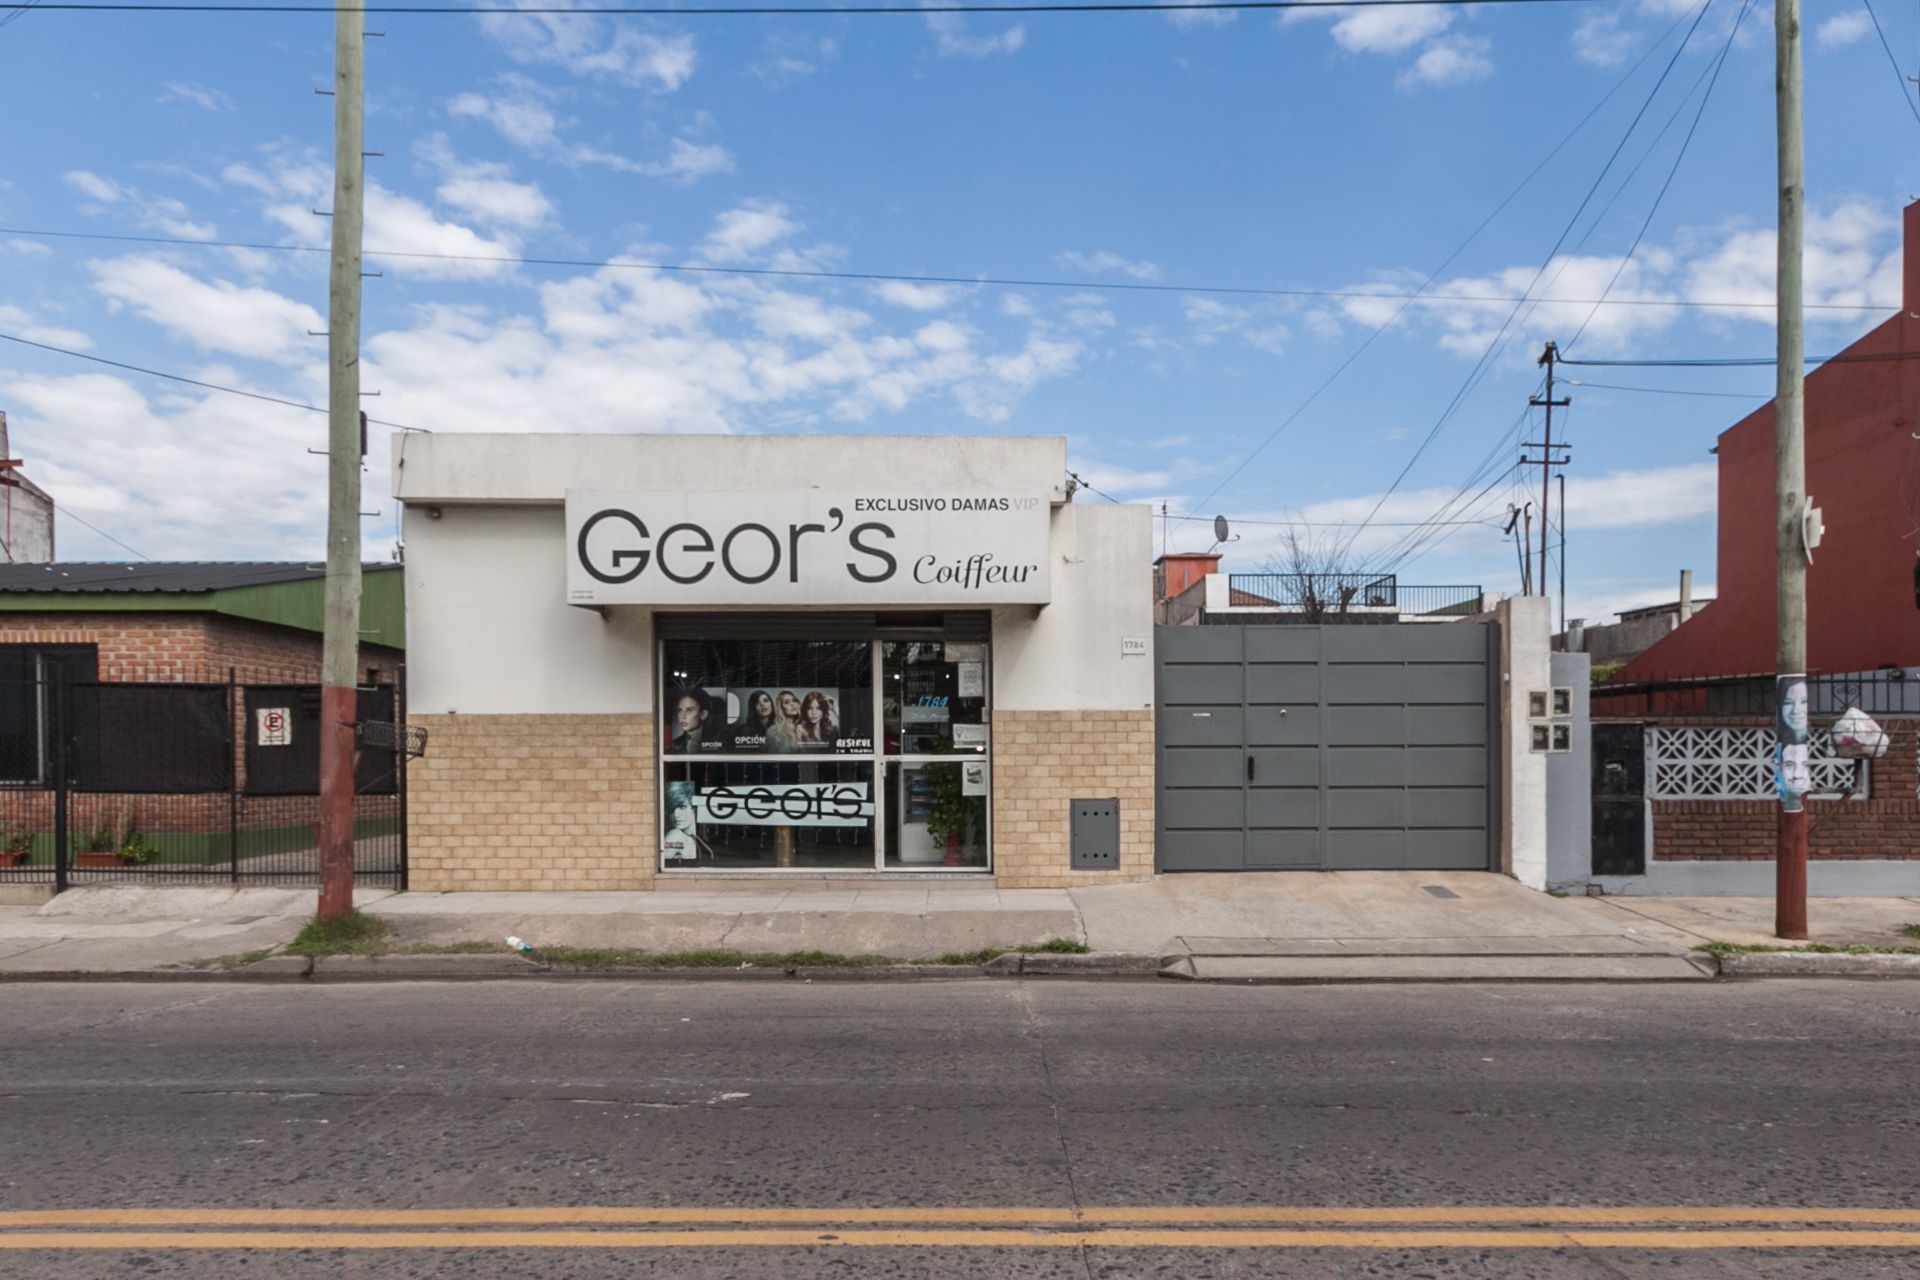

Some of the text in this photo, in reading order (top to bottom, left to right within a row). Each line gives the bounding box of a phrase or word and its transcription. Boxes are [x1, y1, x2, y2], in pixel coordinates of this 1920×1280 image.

[855, 498, 1039, 511] EXCLUSIVO DAMAS VIP
[577, 507, 897, 584] Geor's
[913, 553, 1037, 589] Coiffeur
[1124, 640, 1144, 649] 1784
[918, 696, 949, 708] 1784
[735, 736, 765, 744] OPCIÓN
